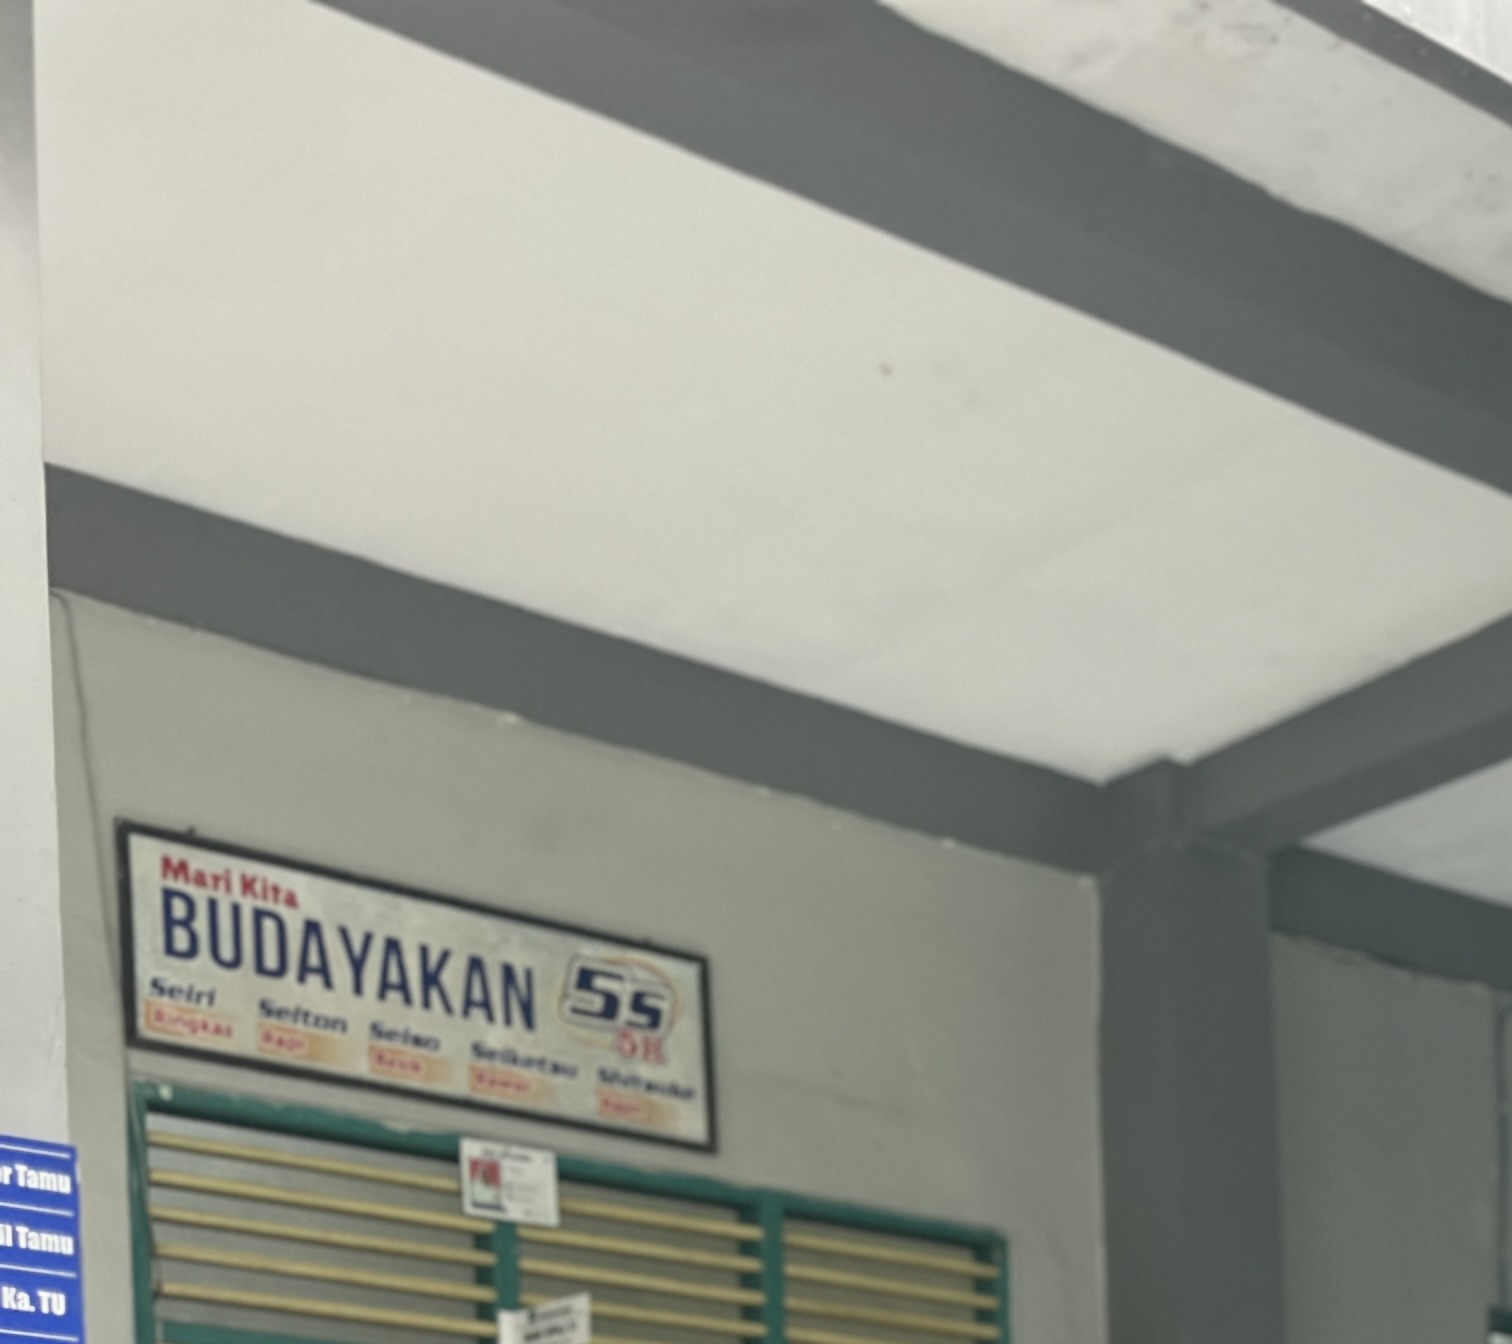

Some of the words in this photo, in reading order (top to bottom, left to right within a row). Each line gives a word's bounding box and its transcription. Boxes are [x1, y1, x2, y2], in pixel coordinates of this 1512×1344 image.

[161, 854, 232, 895] Mari
[241, 873, 299, 910] Kita
[161, 886, 537, 1031] BUDAYAKAN
[150, 976, 216, 1007] Seiri
[15, 1164, 71, 1194] Tamu
[15, 1225, 74, 1256] Tamu
[1, 1286, 36, 1313] Ka.
[37, 1290, 66, 1316] TU
